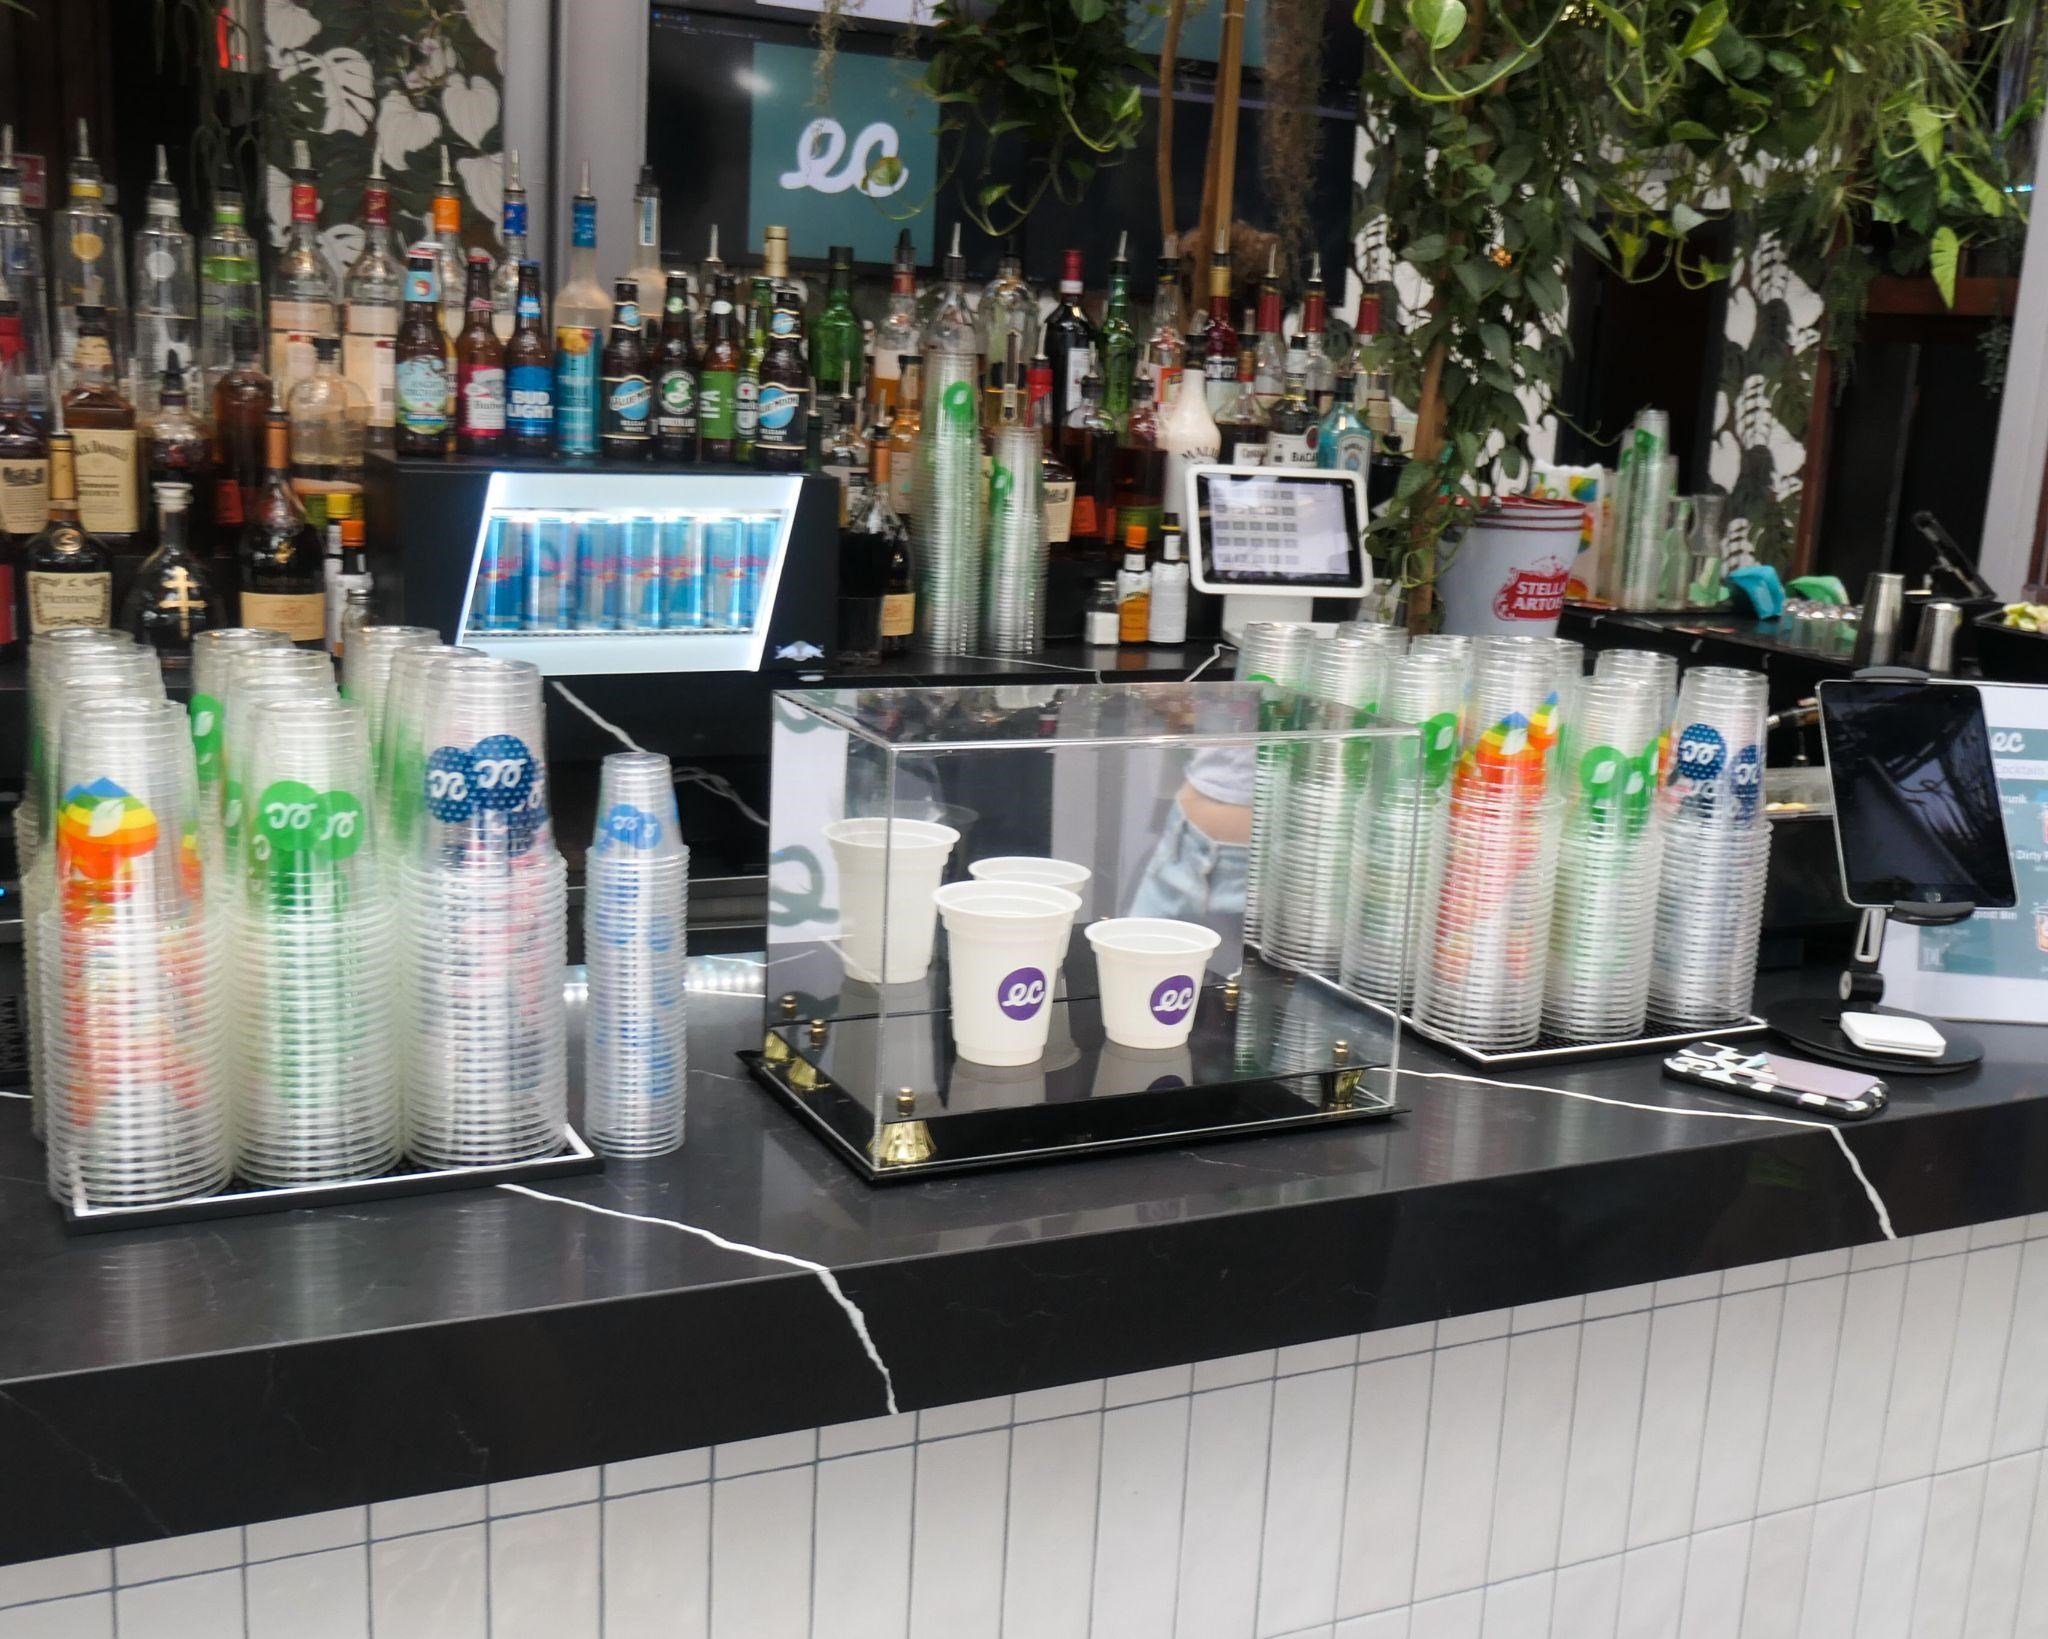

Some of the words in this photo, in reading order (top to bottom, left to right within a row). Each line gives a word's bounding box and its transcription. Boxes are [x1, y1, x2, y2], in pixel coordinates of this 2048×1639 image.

[512, 390, 550, 405] BUD
[506, 404, 554, 419] LIGHT
[1001, 980, 1045, 1007] ec
[1153, 987, 1193, 1012] ec
